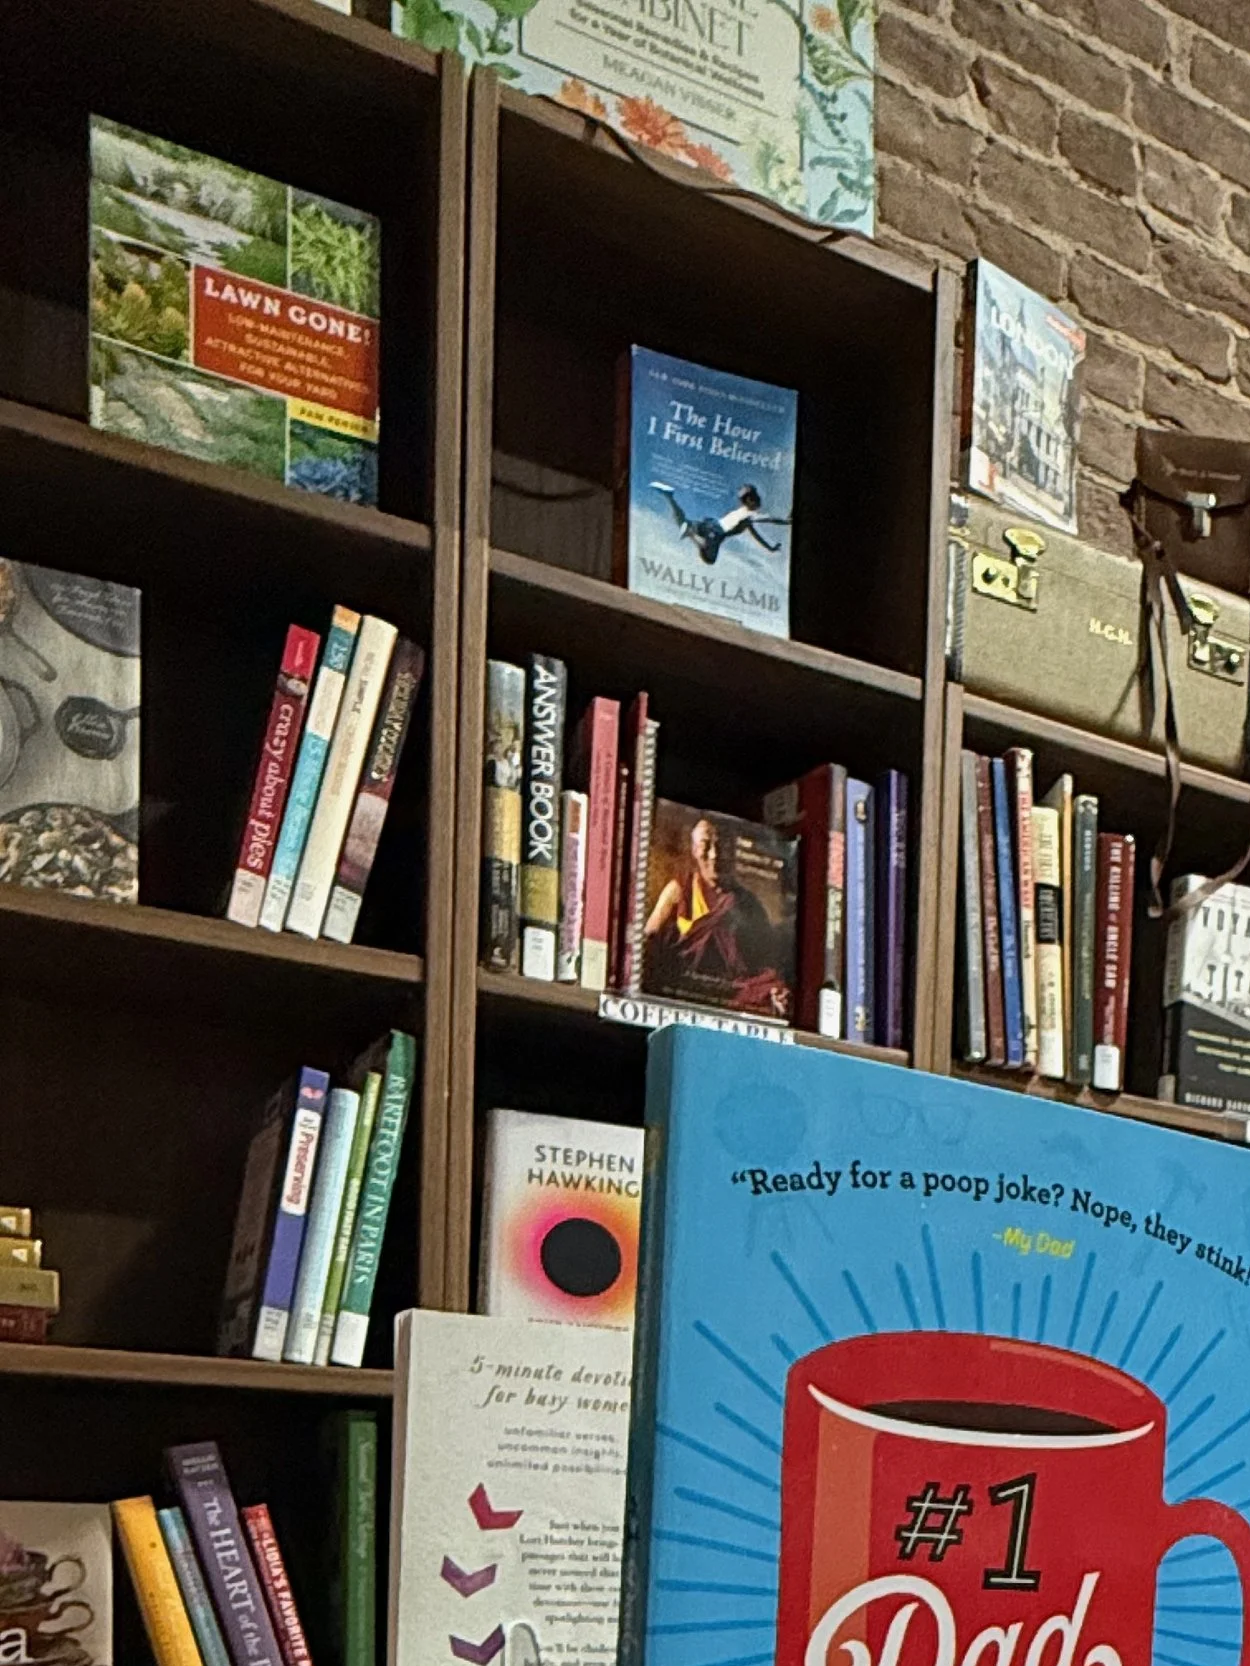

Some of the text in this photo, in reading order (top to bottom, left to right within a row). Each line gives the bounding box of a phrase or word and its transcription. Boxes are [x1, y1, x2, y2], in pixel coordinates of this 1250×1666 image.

[204, 276, 371, 346] LAWN GONE!
[989, 303, 1078, 382] LONDON
[647, 416, 784, 471] I First Believed
[668, 400, 763, 444] The Hour
[638, 556, 783, 613] WALLY LAMB
[245, 702, 296, 872] crazy about pies
[526, 663, 559, 861] ANSWER BOOK
[285, 1130, 314, 1207] Preserving
[352, 1073, 408, 1286] BAREFOOT IN PARIS
[526, 1167, 641, 1199] HAWKING
[533, 1143, 637, 1175] STEPHEN
[730, 1161, 843, 1197] “Ready
[849, 1160, 893, 1190] for
[900, 1170, 916, 1189] a
[922, 1172, 990, 1203] poop
[996, 1172, 1066, 1208] joke?
[1070, 1187, 1138, 1234] Nope,
[1142, 1208, 1192, 1255] they
[1036, 1233, 1077, 1260] Dad
[469, 1355, 564, 1382] 5-minute
[475, 1384, 630, 1414] for busy wome
[201, 1496, 223, 1527] The
[894, 1471, 1043, 1592] #1
[208, 1527, 255, 1614] HEART
